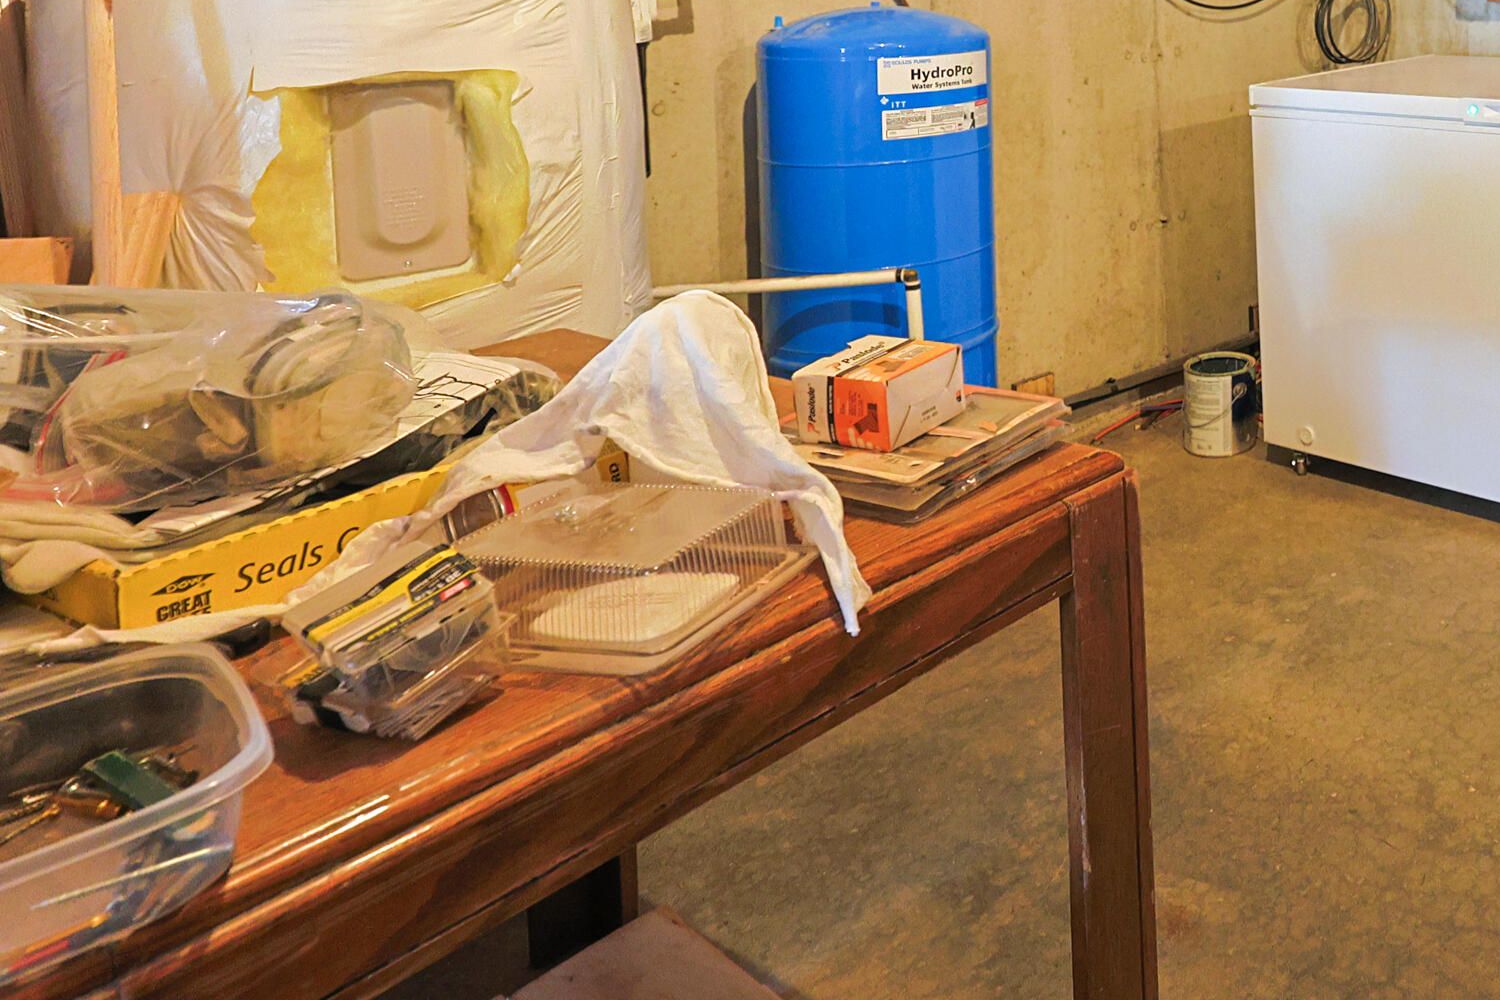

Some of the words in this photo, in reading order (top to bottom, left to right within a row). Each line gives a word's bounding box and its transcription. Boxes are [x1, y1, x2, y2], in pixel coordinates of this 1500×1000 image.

[910, 65, 973, 83] HydroPro
[935, 81, 960, 89] Systems
[891, 100, 906, 109] ITT
[841, 342, 884, 364] Paslode
[807, 386, 816, 423] Paslode
[234, 541, 324, 593] Seals
[166, 576, 203, 593] DOW
[157, 590, 212, 623] GREAT
